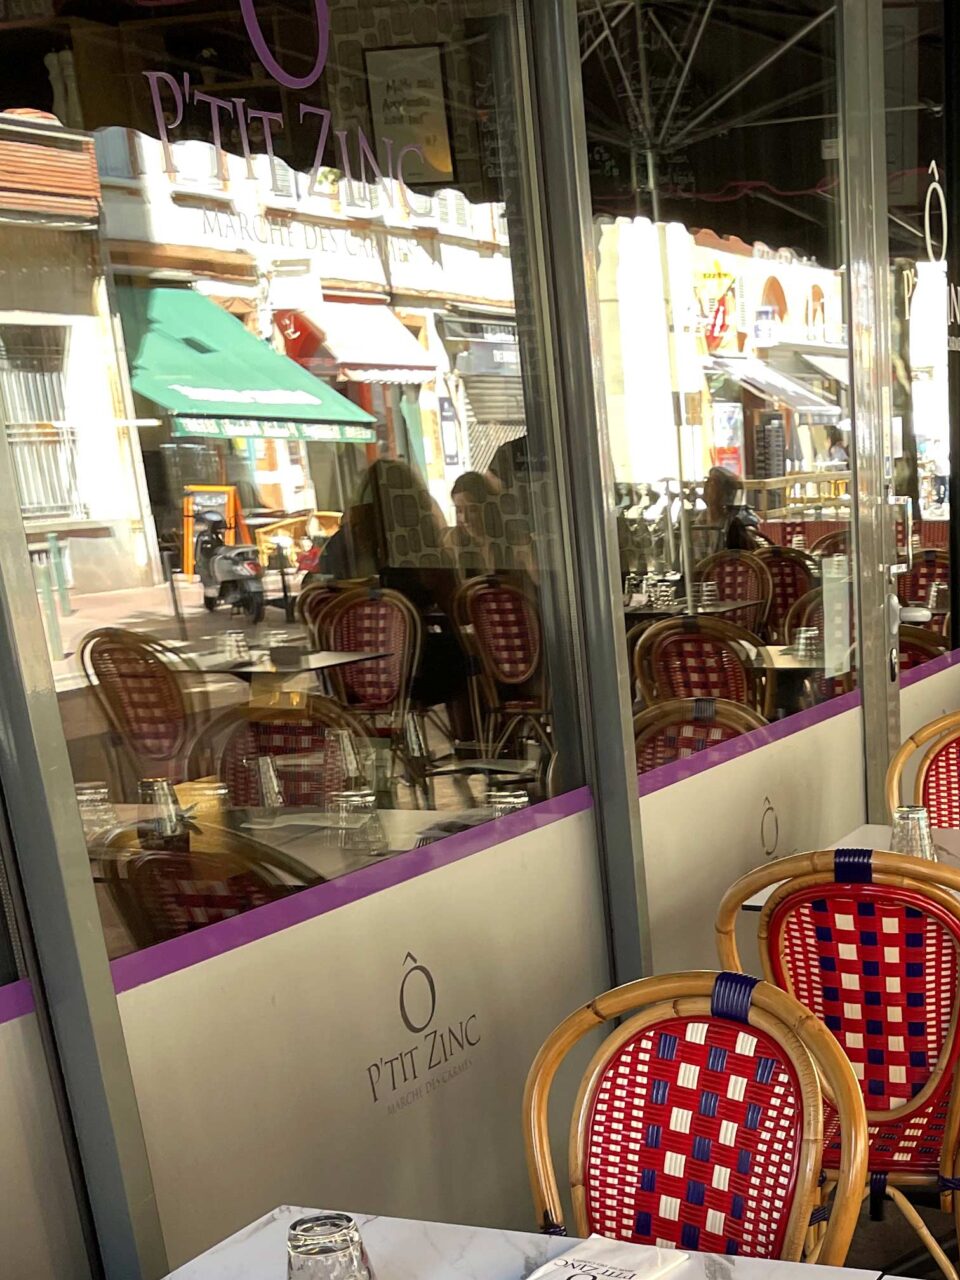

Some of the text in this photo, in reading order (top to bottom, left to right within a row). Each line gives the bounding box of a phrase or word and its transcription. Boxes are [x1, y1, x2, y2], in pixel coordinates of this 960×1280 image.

[142, 71, 284, 194] P'TIT
[300, 103, 433, 218] ZINC
[924, 159, 948, 263] Ô
[399, 951, 437, 1034] Ô
[366, 1014, 481, 1103] P'TIT ZINC
